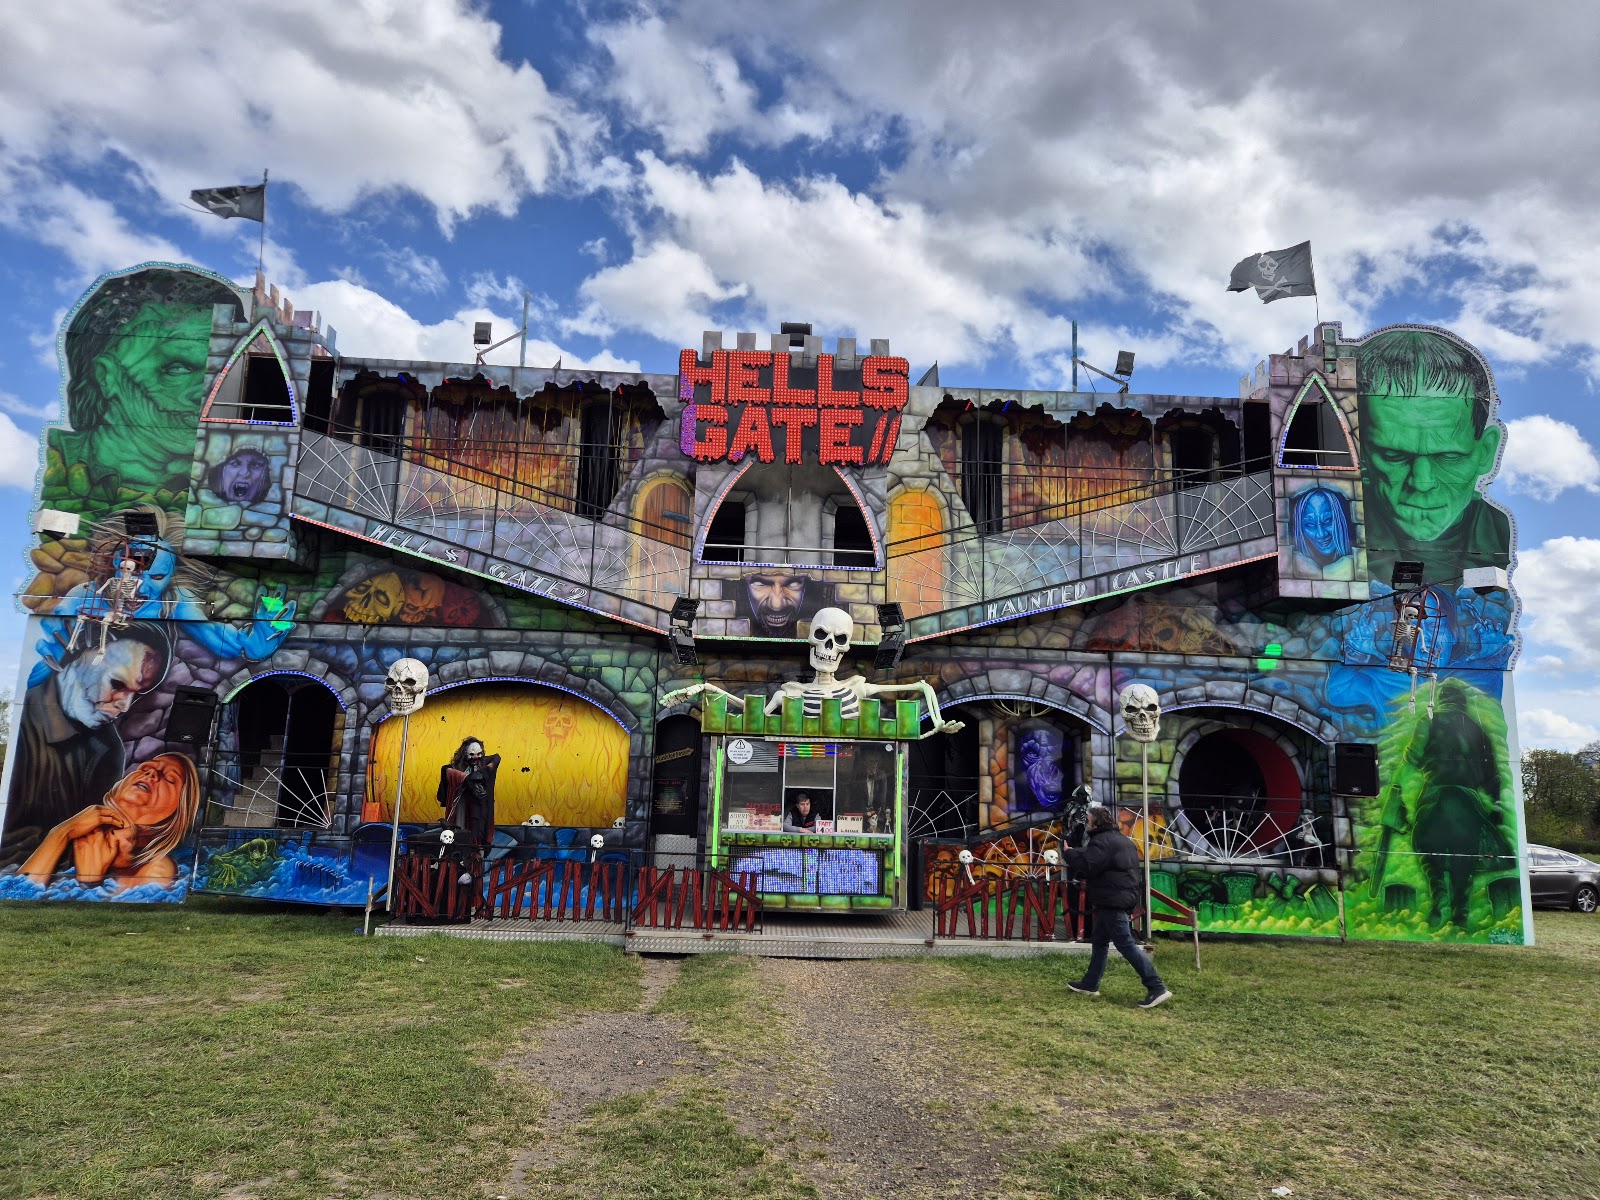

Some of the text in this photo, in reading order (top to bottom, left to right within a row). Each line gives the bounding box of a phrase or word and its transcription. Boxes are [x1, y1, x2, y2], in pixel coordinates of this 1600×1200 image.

[679, 348, 909, 412] HELLS
[680, 403, 864, 465] GATE
[987, 555, 1203, 621] HAUNTED CASTLE
